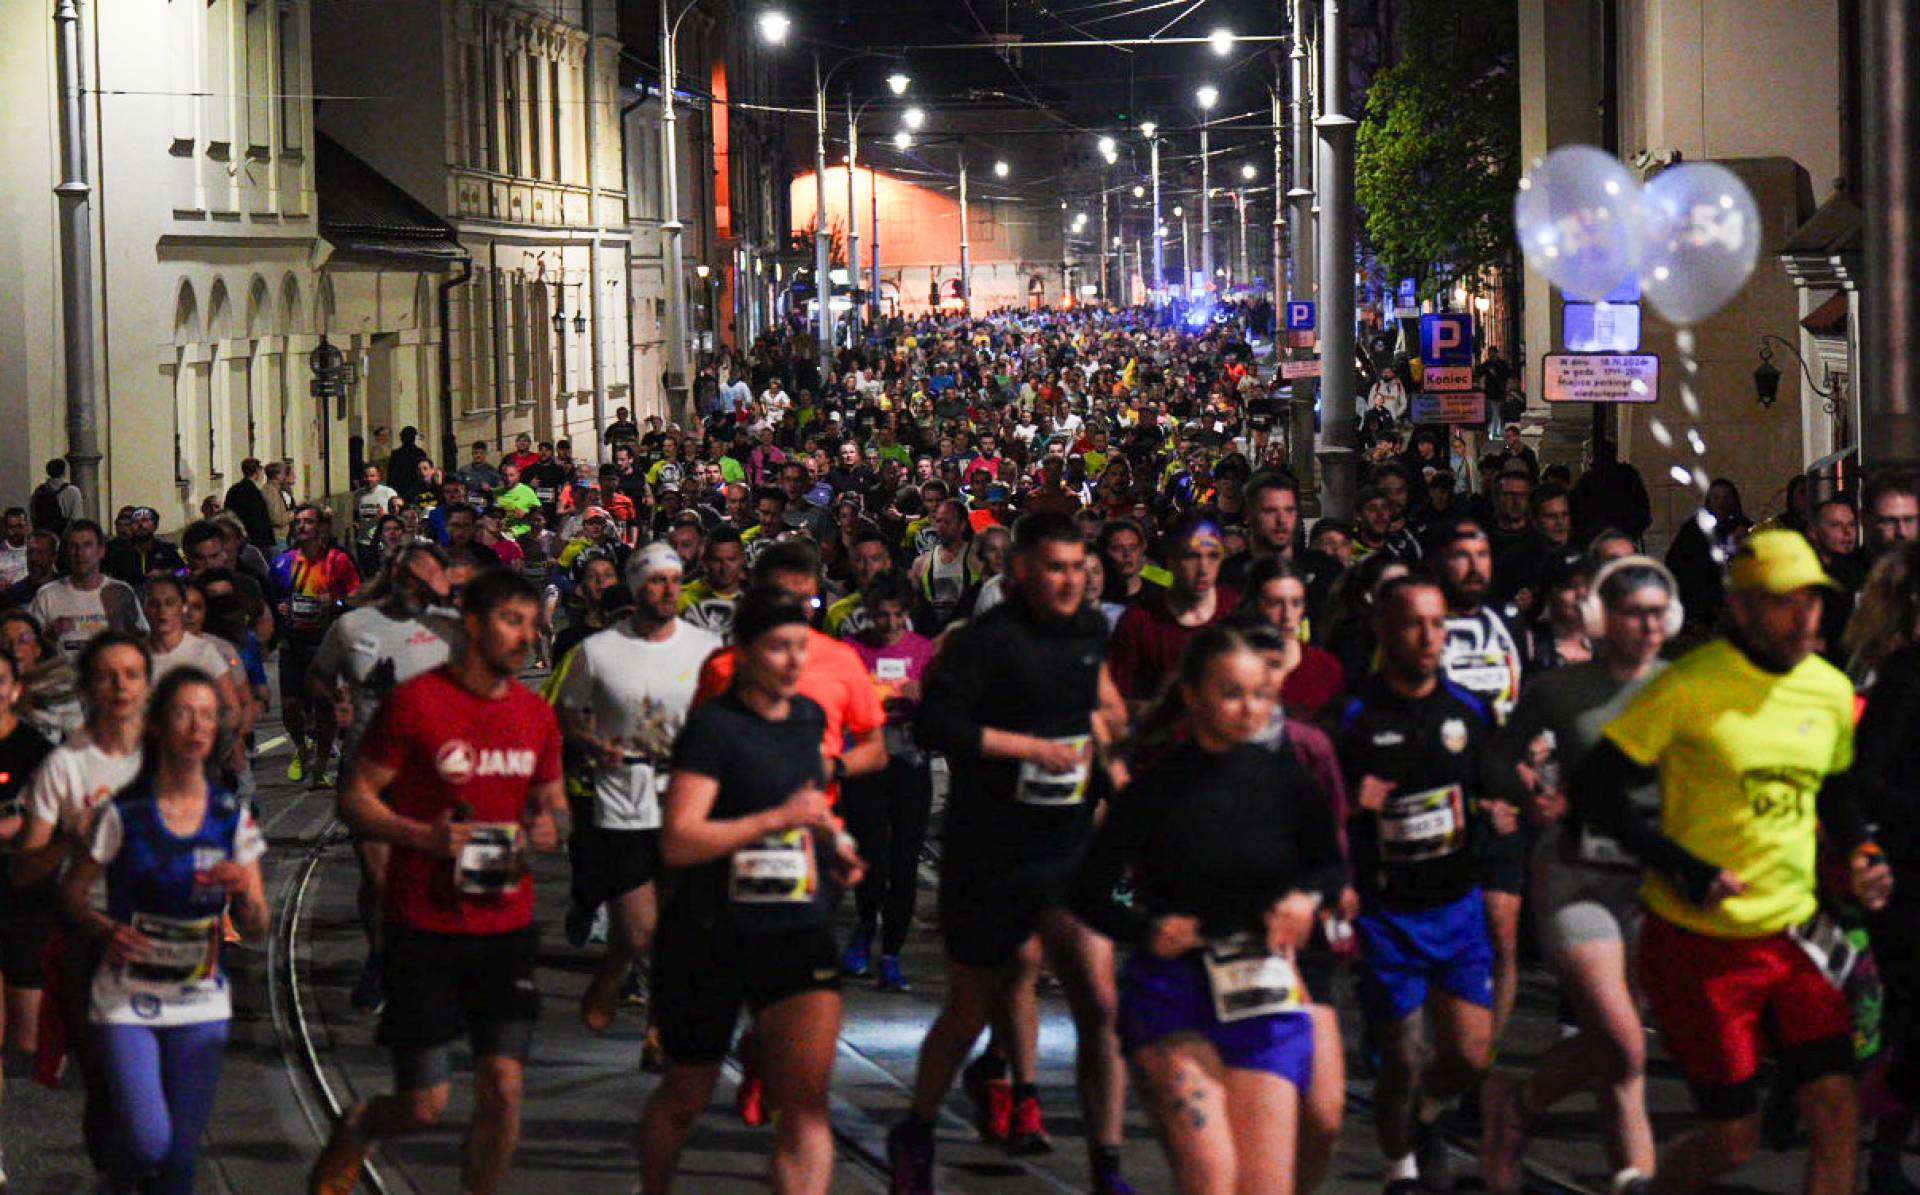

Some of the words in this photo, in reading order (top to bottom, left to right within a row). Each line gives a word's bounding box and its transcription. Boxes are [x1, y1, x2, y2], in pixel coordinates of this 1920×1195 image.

[1401, 280, 1411, 294] P
[1292, 304, 1309, 327] P
[1431, 320, 1461, 359] P
[1426, 374, 1468, 385] Koniec
